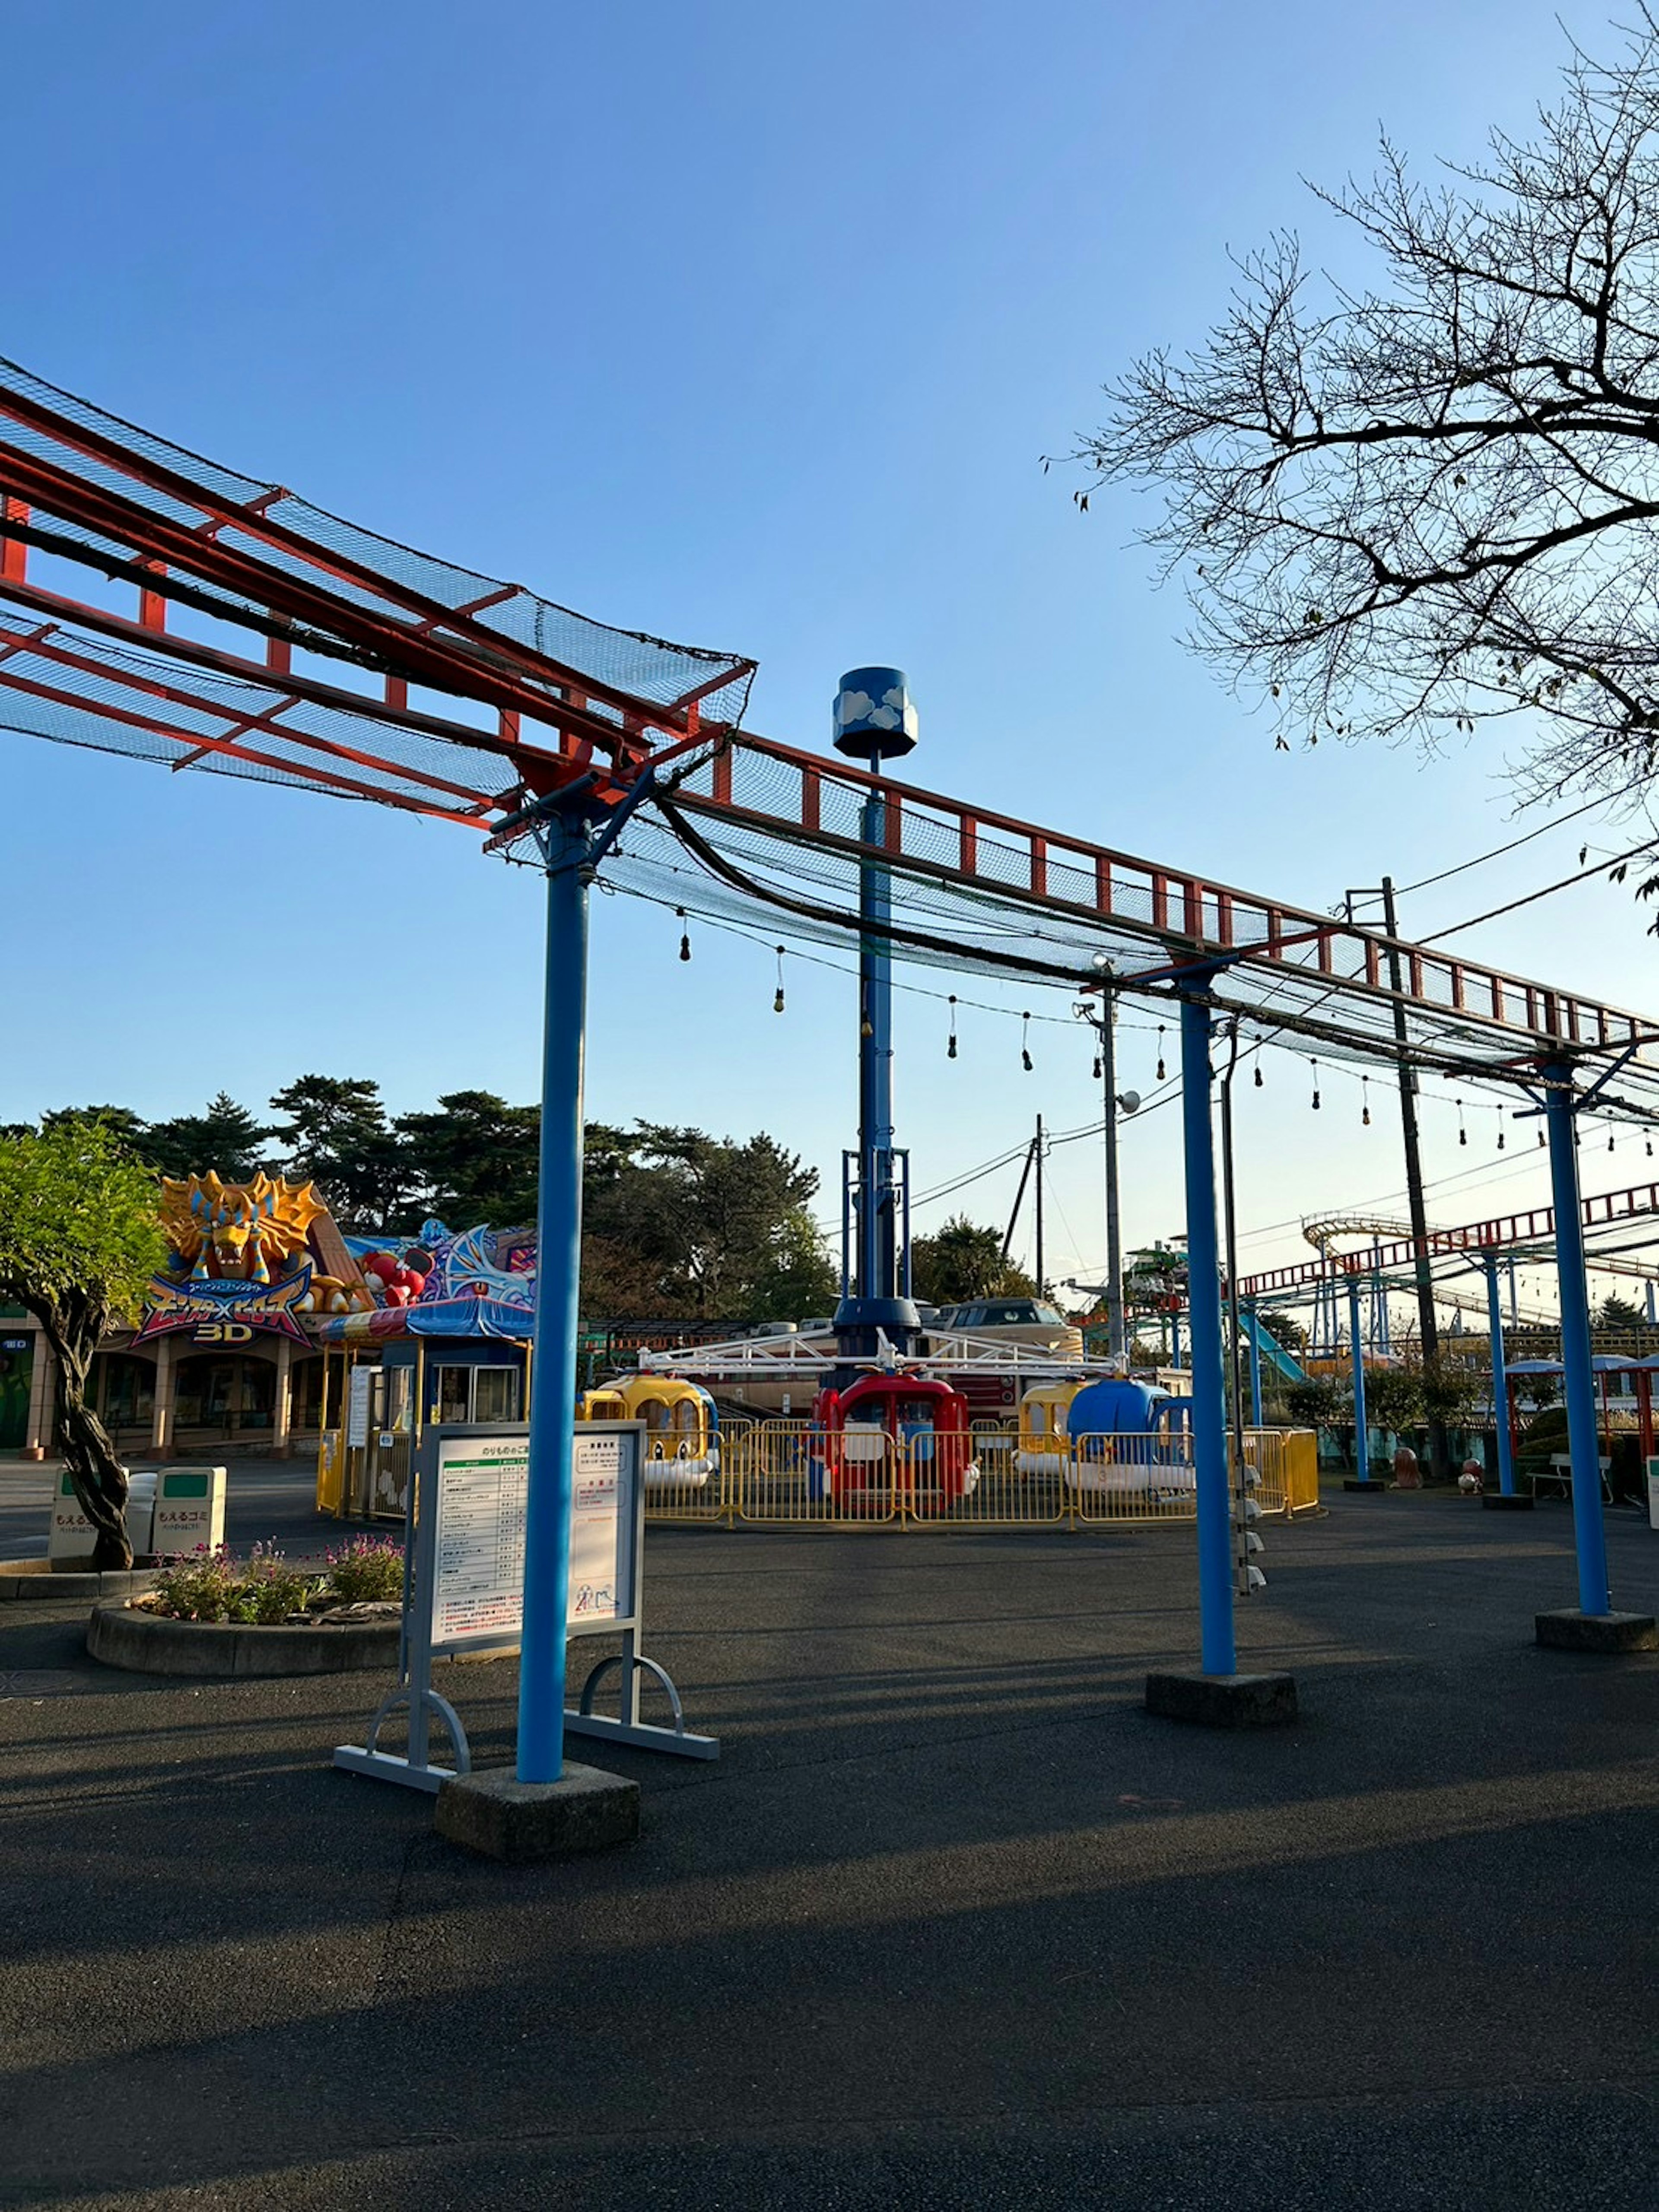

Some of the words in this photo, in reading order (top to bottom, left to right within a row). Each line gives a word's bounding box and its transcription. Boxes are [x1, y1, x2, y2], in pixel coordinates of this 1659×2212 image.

[193, 1323, 253, 1342] 3D
[57, 1515, 90, 1525] もえる
[159, 1511, 208, 1521] もえるゴミ
